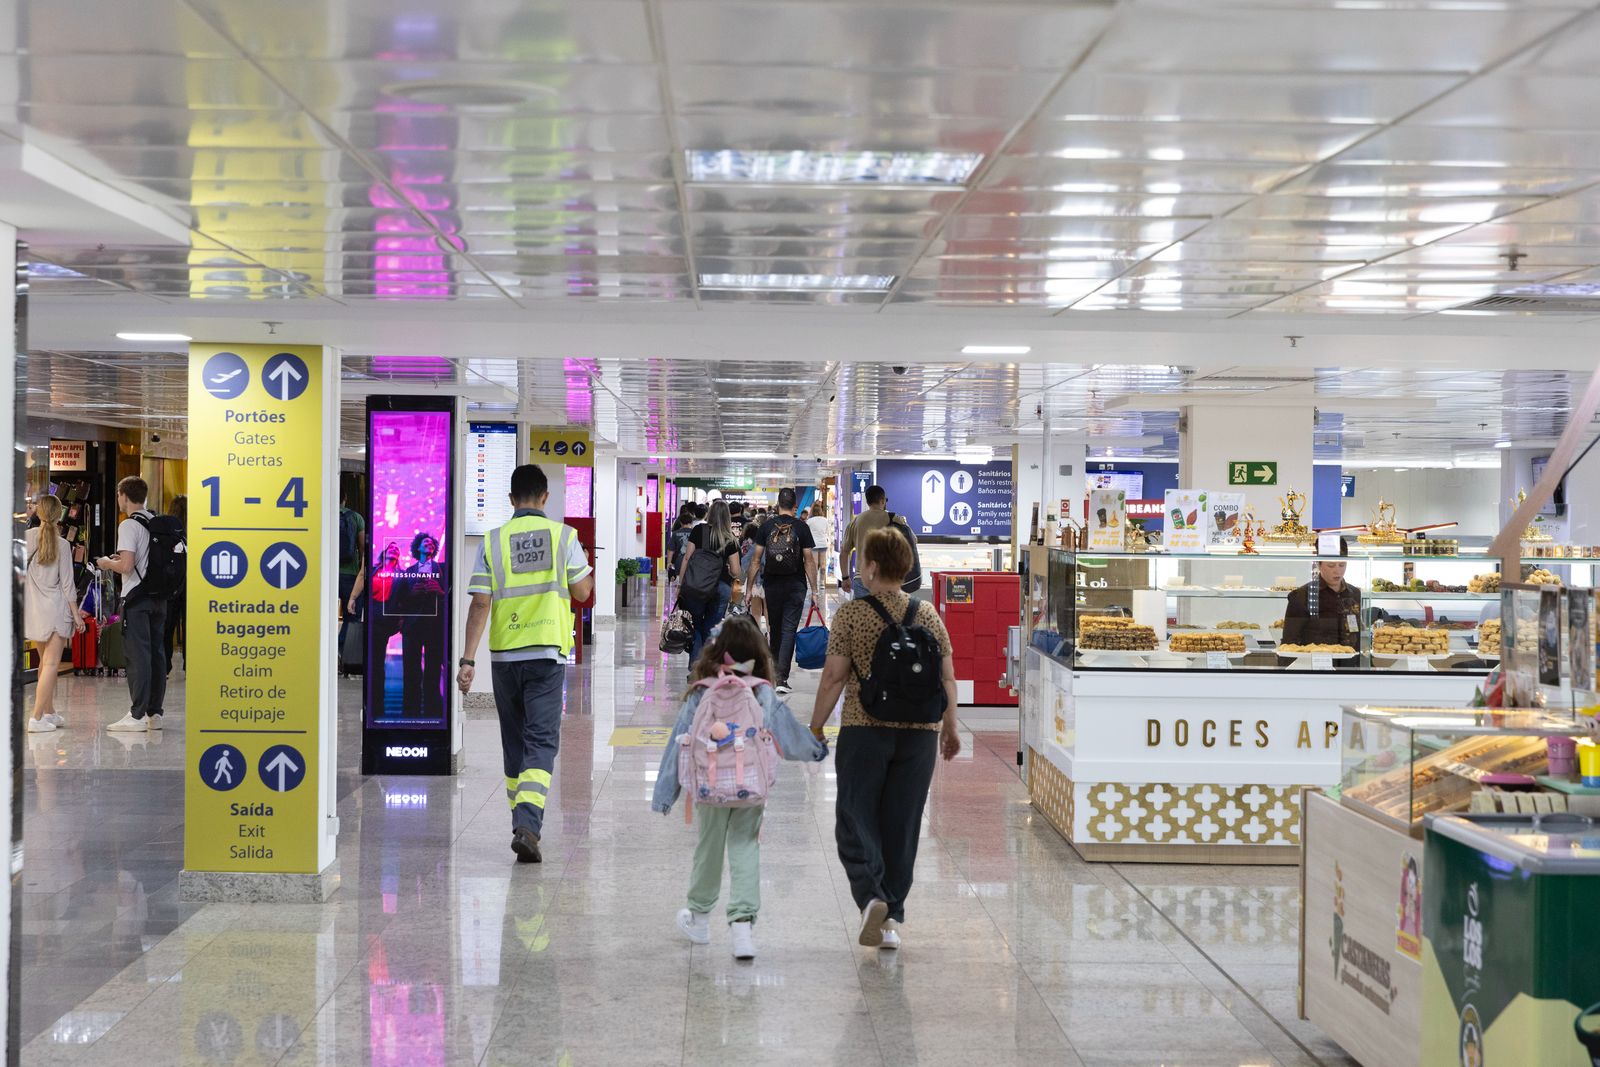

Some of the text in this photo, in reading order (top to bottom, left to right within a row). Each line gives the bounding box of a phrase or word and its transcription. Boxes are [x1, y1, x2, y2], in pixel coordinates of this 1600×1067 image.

[225, 409, 286, 424] Portões
[234, 431, 276, 445] Gates
[538, 440, 551, 455] 4
[227, 452, 283, 467] Puertas
[201, 475, 309, 519] 1 - 4
[978, 487, 996, 495] Baños
[977, 501, 1008, 509] Sanitário
[1213, 504, 1239, 512] COMBO
[977, 510, 998, 518] Family
[518, 551, 545, 563] 0297
[208, 599, 300, 615] Retirada de
[216, 620, 291, 639] bagagem
[221, 642, 286, 660] Baggage
[233, 663, 273, 678] claim
[220, 684, 287, 699] Retiro de
[220, 705, 286, 724] equipaje
[1147, 719, 1269, 748] DOCES
[385, 746, 428, 758] NEOOH
[230, 802, 274, 817] Saída
[239, 824, 265, 838] Exit
[230, 845, 273, 859] Salida
